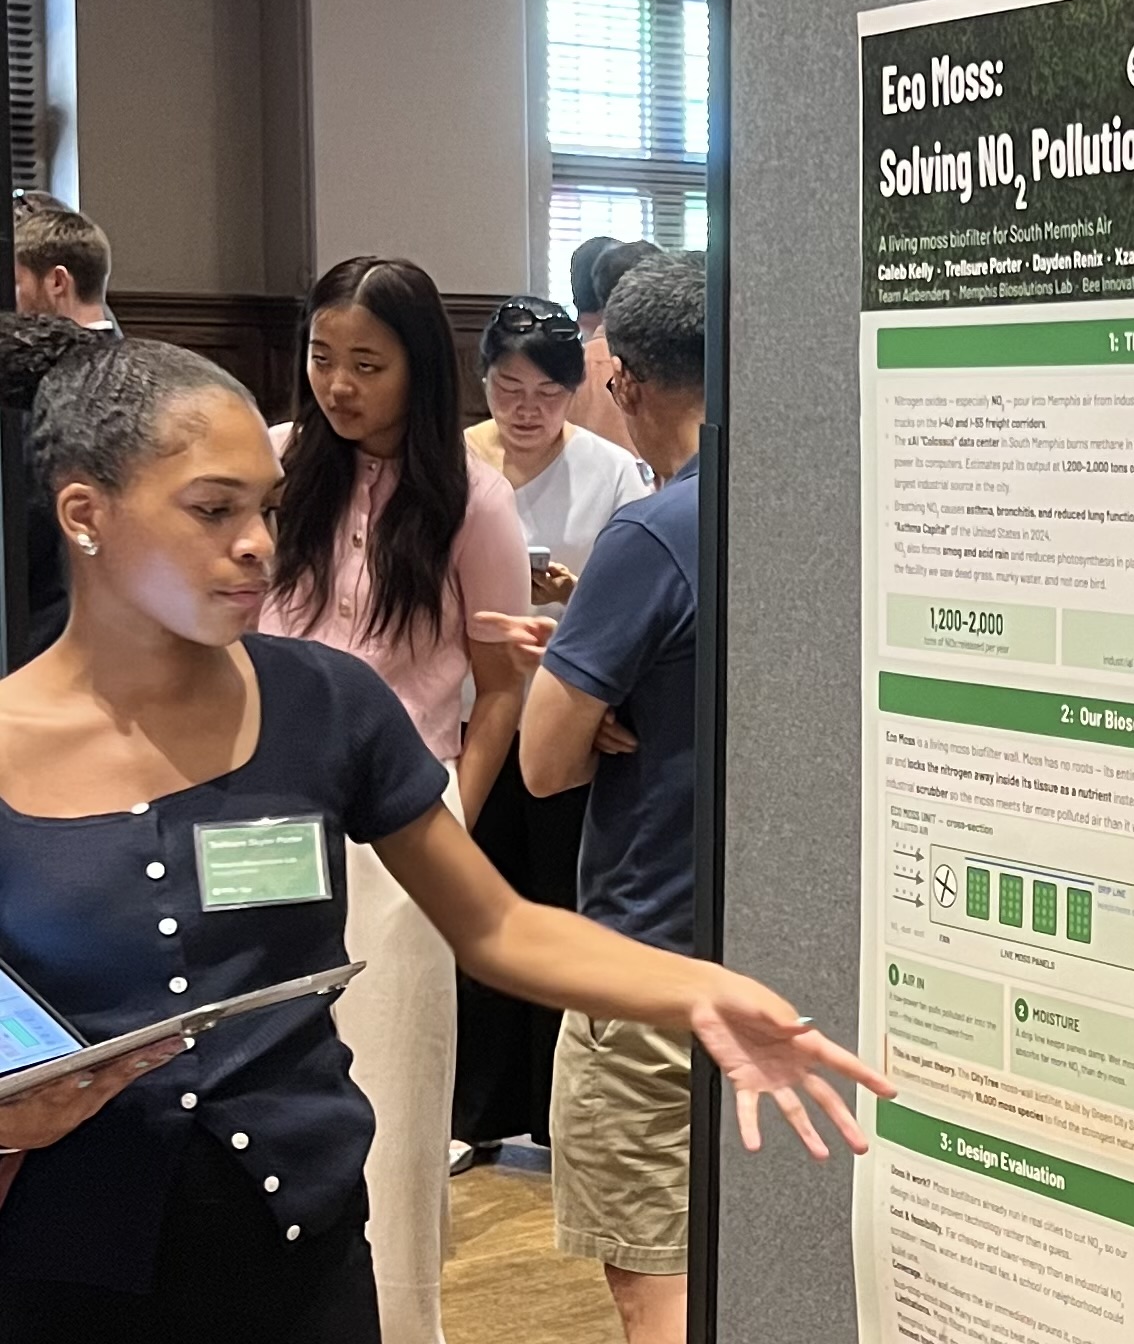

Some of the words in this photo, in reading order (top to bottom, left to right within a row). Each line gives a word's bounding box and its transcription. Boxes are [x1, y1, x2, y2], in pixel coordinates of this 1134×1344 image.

[881, 65, 926, 115] Eco
[931, 55, 1004, 108] Moss:
[879, 141, 972, 204] Solving
[978, 133, 1027, 210] NO2
[877, 234, 886, 254] A
[888, 234, 918, 254] living
[919, 234, 948, 250] moss
[948, 228, 991, 248] biofilter
[992, 226, 1008, 245] for
[1008, 223, 1042, 243] South
[1043, 219, 1094, 243] Memphis
[1095, 218, 1112, 235] Air
[877, 262, 907, 281] Caleb
[907, 261, 934, 281] Kelly
[988, 255, 1022, 275] Porter
[1032, 251, 1072, 273] Dayden
[1072, 247, 1104, 269] Renix
[1109, 331, 1119, 352] 1:
[1060, 703, 1074, 723] 2:
[1079, 705, 1102, 727] Our
[901, 972, 915, 986] AIR
[916, 976, 924, 990] IN
[1018, 1003, 1025, 1017] 2
[1033, 1008, 1080, 1033] MOISTURE
[939, 1131, 952, 1152] 3:
[956, 1136, 998, 1168] Design
[999, 1150, 1065, 1190] Evaluation
